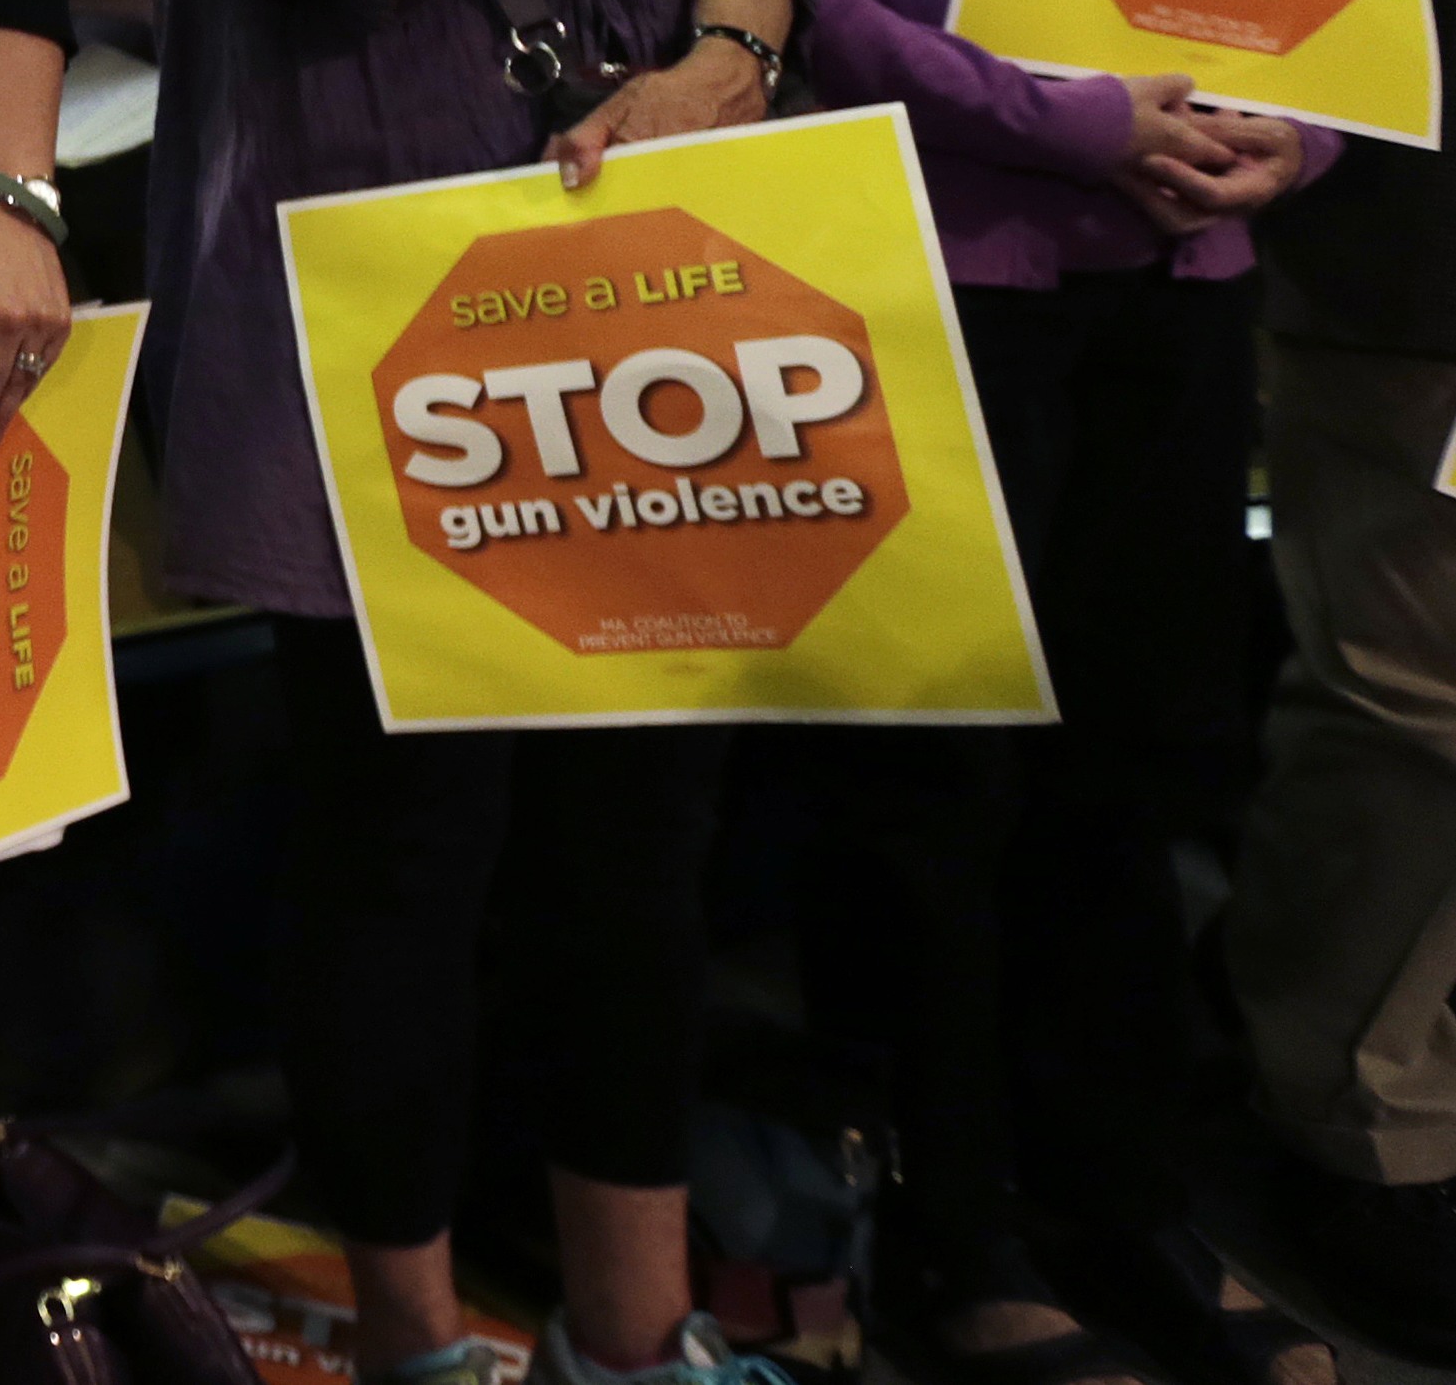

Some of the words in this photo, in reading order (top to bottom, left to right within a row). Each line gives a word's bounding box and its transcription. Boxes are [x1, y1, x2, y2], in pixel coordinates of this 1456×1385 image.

[451, 283, 568, 327] save
[586, 276, 617, 310] a
[635, 260, 744, 303] LIFE
[393, 335, 863, 487] STOP
[9, 450, 33, 551] save
[440, 498, 561, 549] gun
[575, 478, 864, 530] violence
[8, 564, 29, 591] a
[10, 603, 34, 690] LIFE
